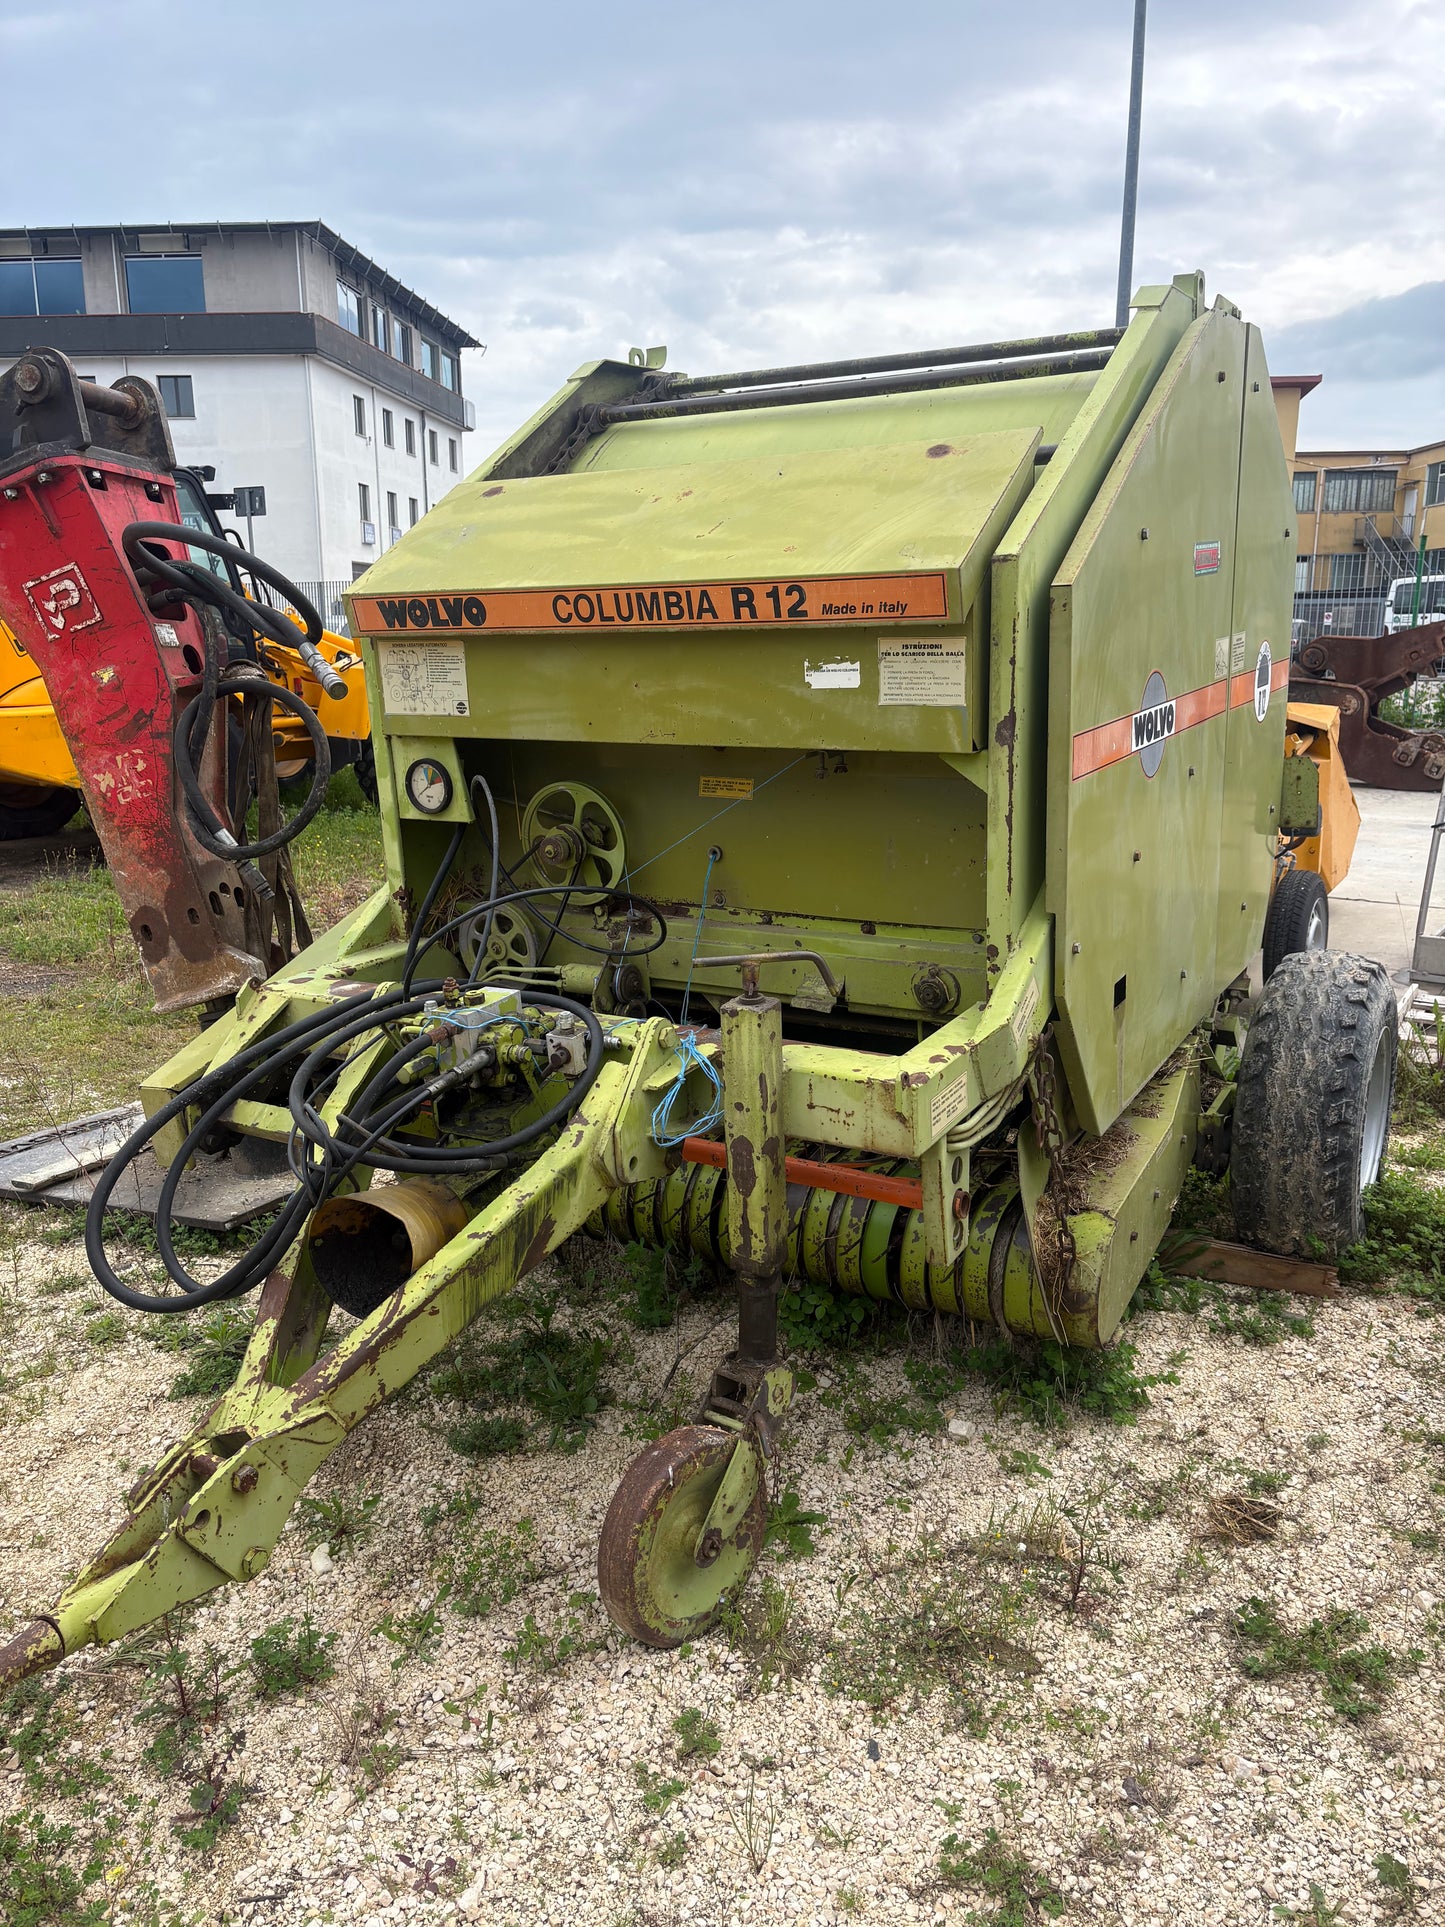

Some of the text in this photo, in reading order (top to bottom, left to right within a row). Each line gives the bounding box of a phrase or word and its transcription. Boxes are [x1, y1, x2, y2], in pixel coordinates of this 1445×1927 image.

[376, 596, 487, 629] WOLVO
[552, 589, 720, 624] COLUMBIA
[821, 603, 857, 615] Made
[861, 602, 874, 614] in
[1134, 703, 1174, 747] WOLVO
